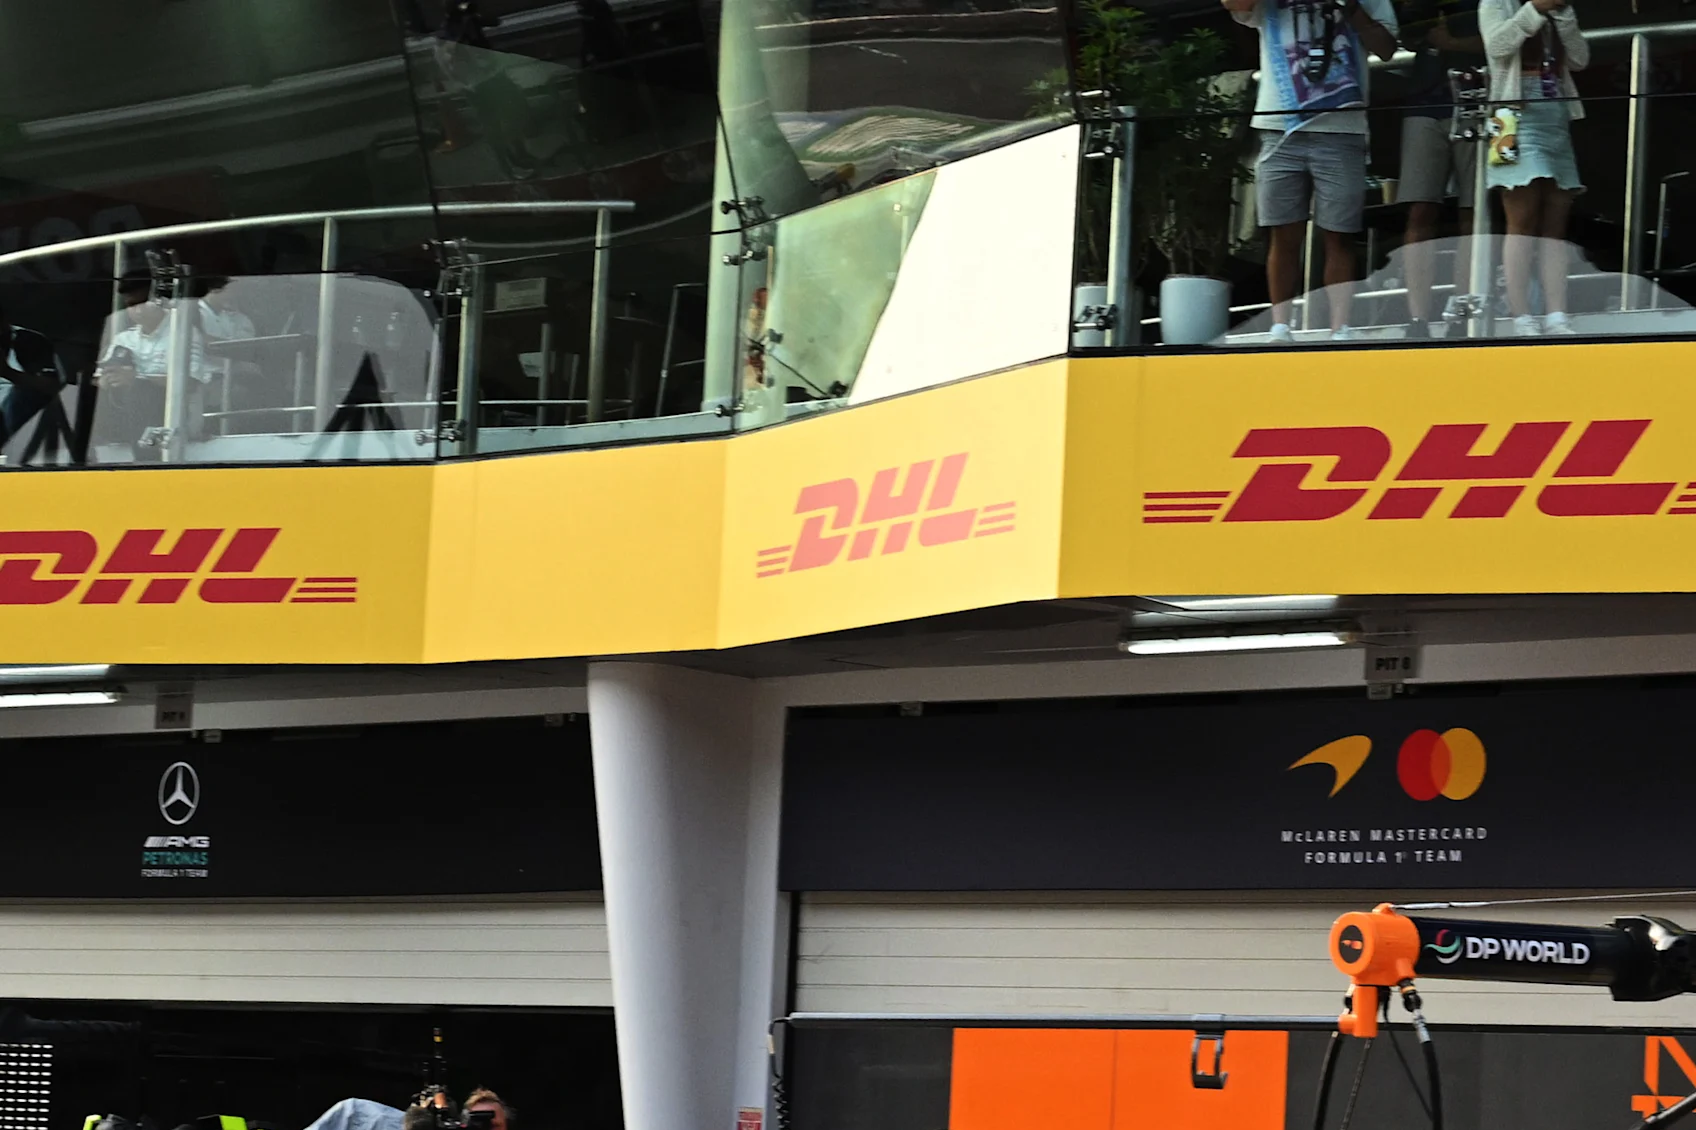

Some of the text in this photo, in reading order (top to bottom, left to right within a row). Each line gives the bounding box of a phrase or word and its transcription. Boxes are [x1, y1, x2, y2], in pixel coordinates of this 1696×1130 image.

[1221, 419, 1678, 523] DHL
[788, 451, 978, 572] DHL
[0, 527, 298, 605] DHL
[1375, 657, 1400, 671] PIT
[1281, 827, 1488, 843] McLAREN MASTERCARD
[142, 852, 208, 865] PETRONAS
[1304, 852, 1388, 864] FORMULA
[1414, 850, 1463, 863] TEAM
[1465, 936, 1590, 965] DP WORLD
